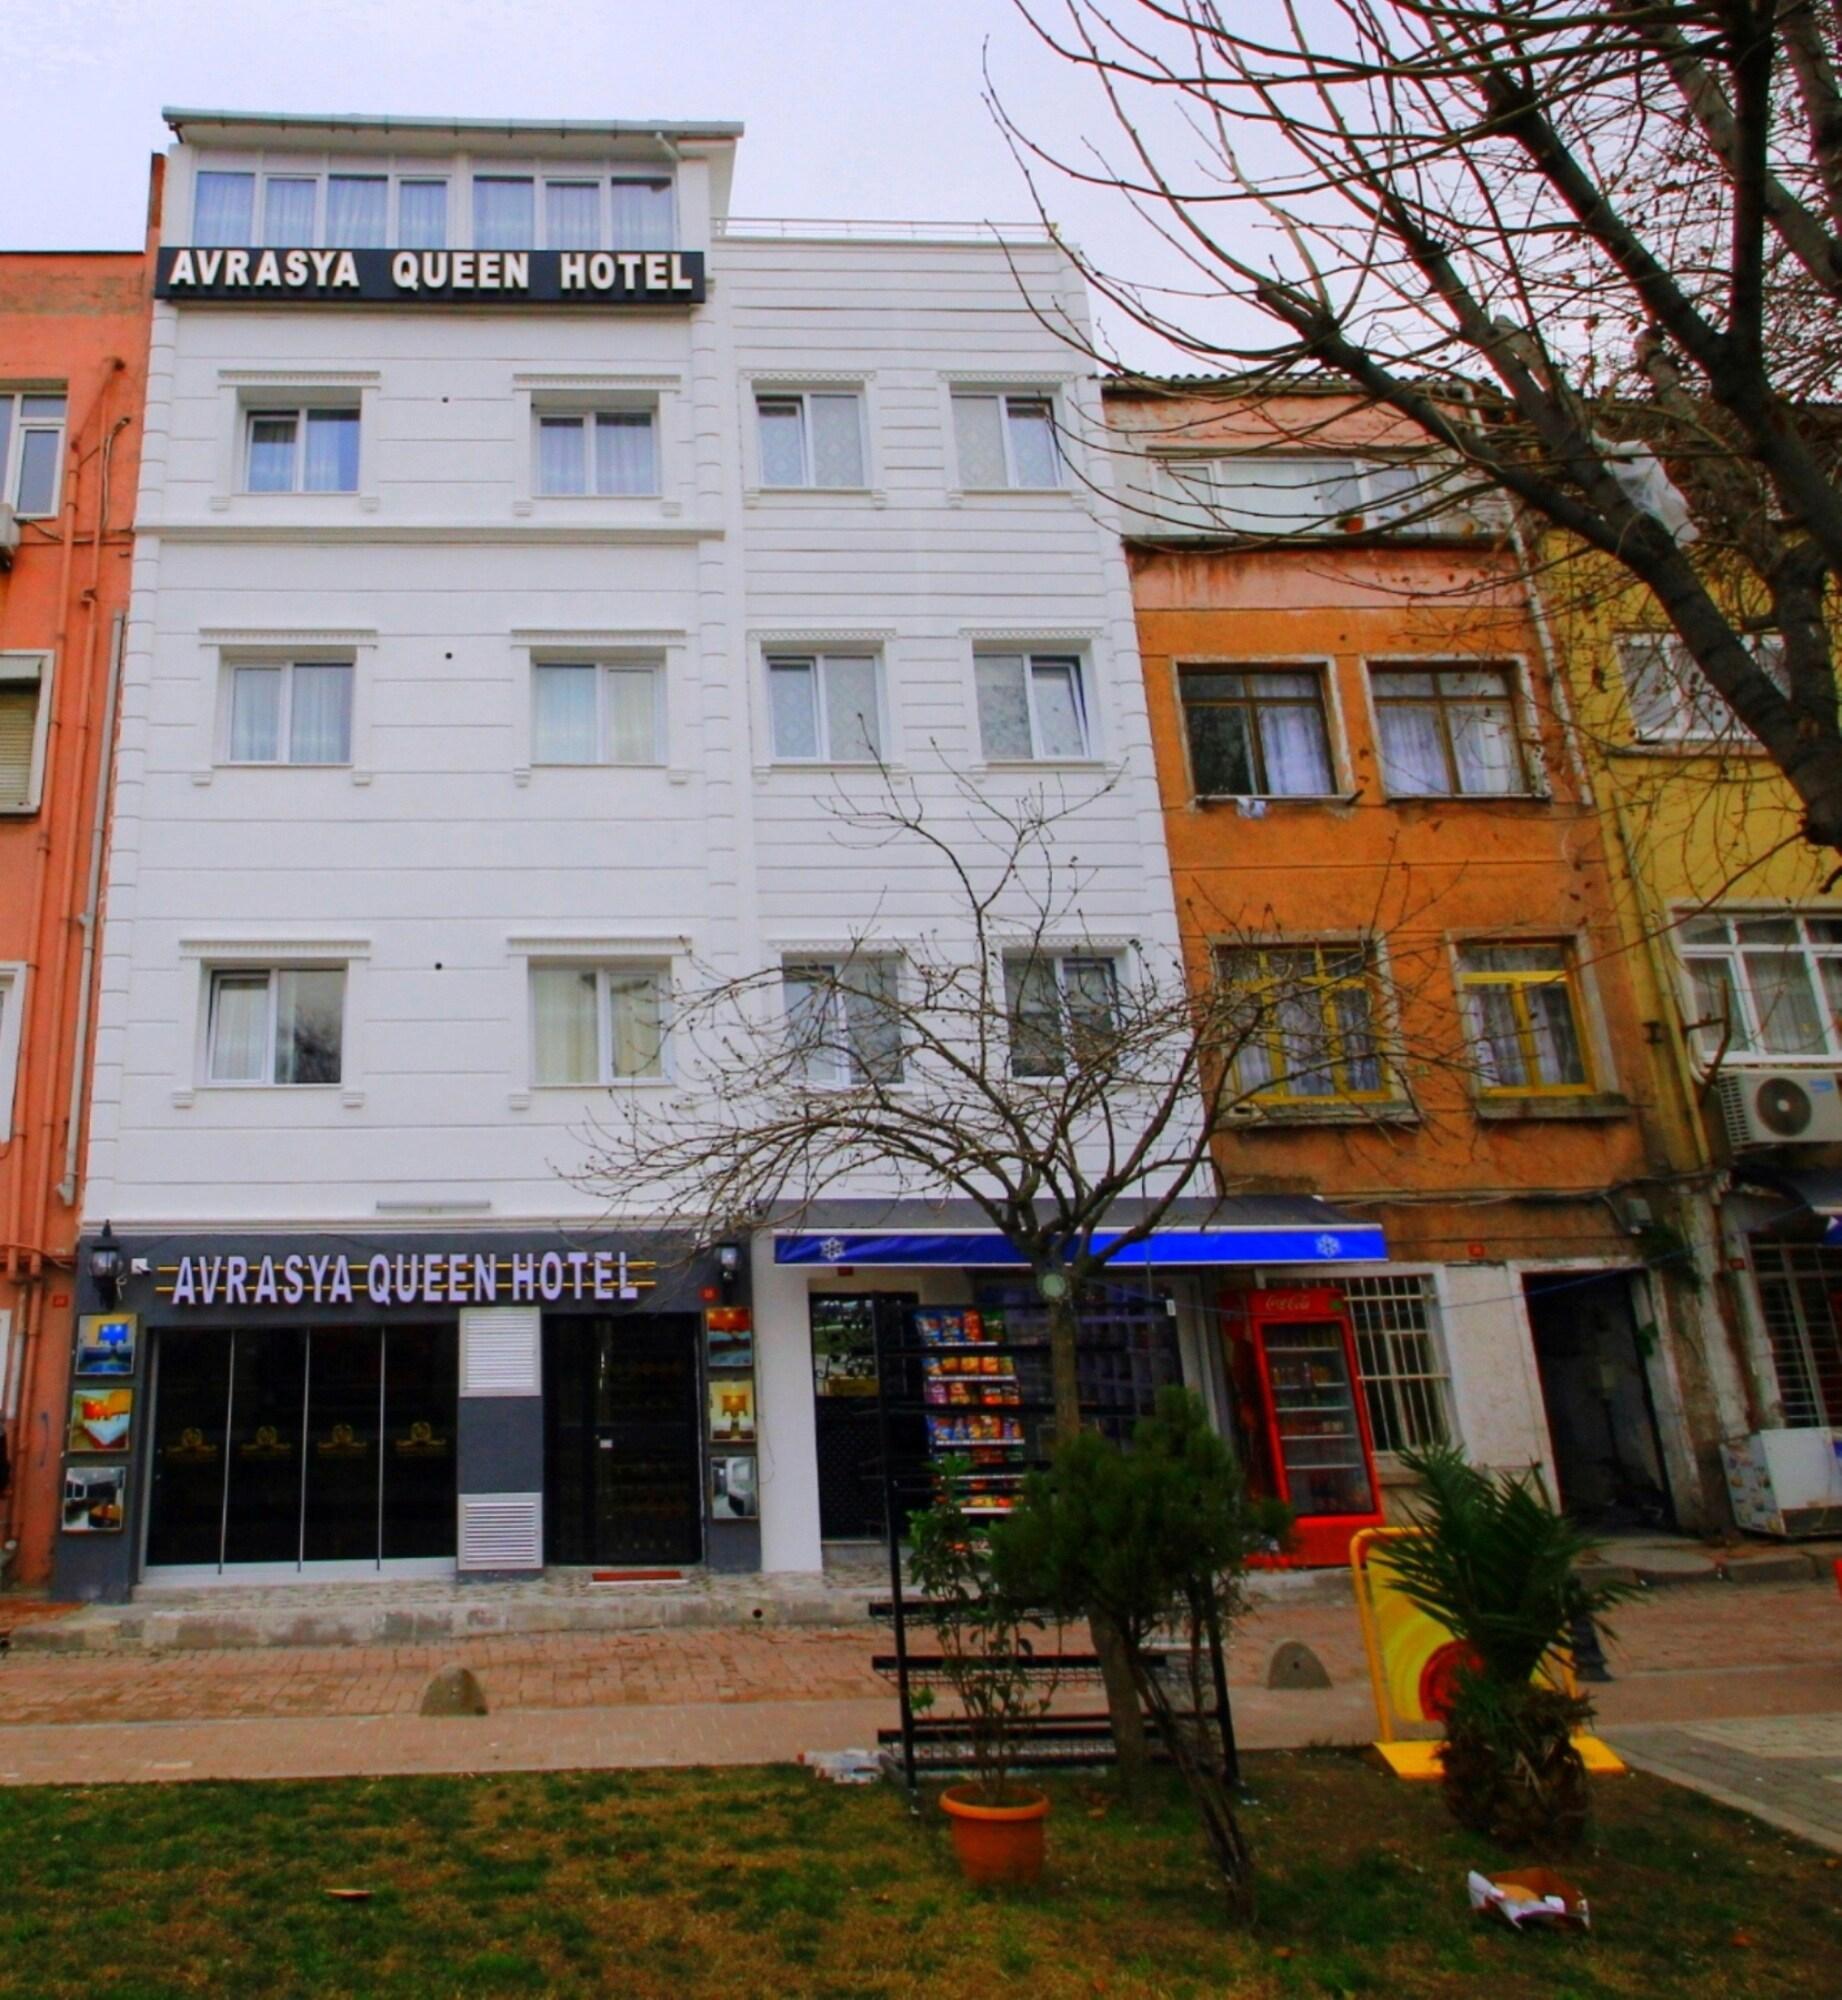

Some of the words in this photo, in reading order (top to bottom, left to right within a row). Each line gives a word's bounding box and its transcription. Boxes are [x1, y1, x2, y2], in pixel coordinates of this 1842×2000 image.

[168, 250, 360, 288] AVRASYA
[391, 252, 530, 292] QUEEN
[560, 253, 693, 290] HOTEL
[172, 1255, 354, 1305] AVRASYA
[367, 1252, 497, 1306] QUEEN
[512, 1250, 639, 1302] HOTEL
